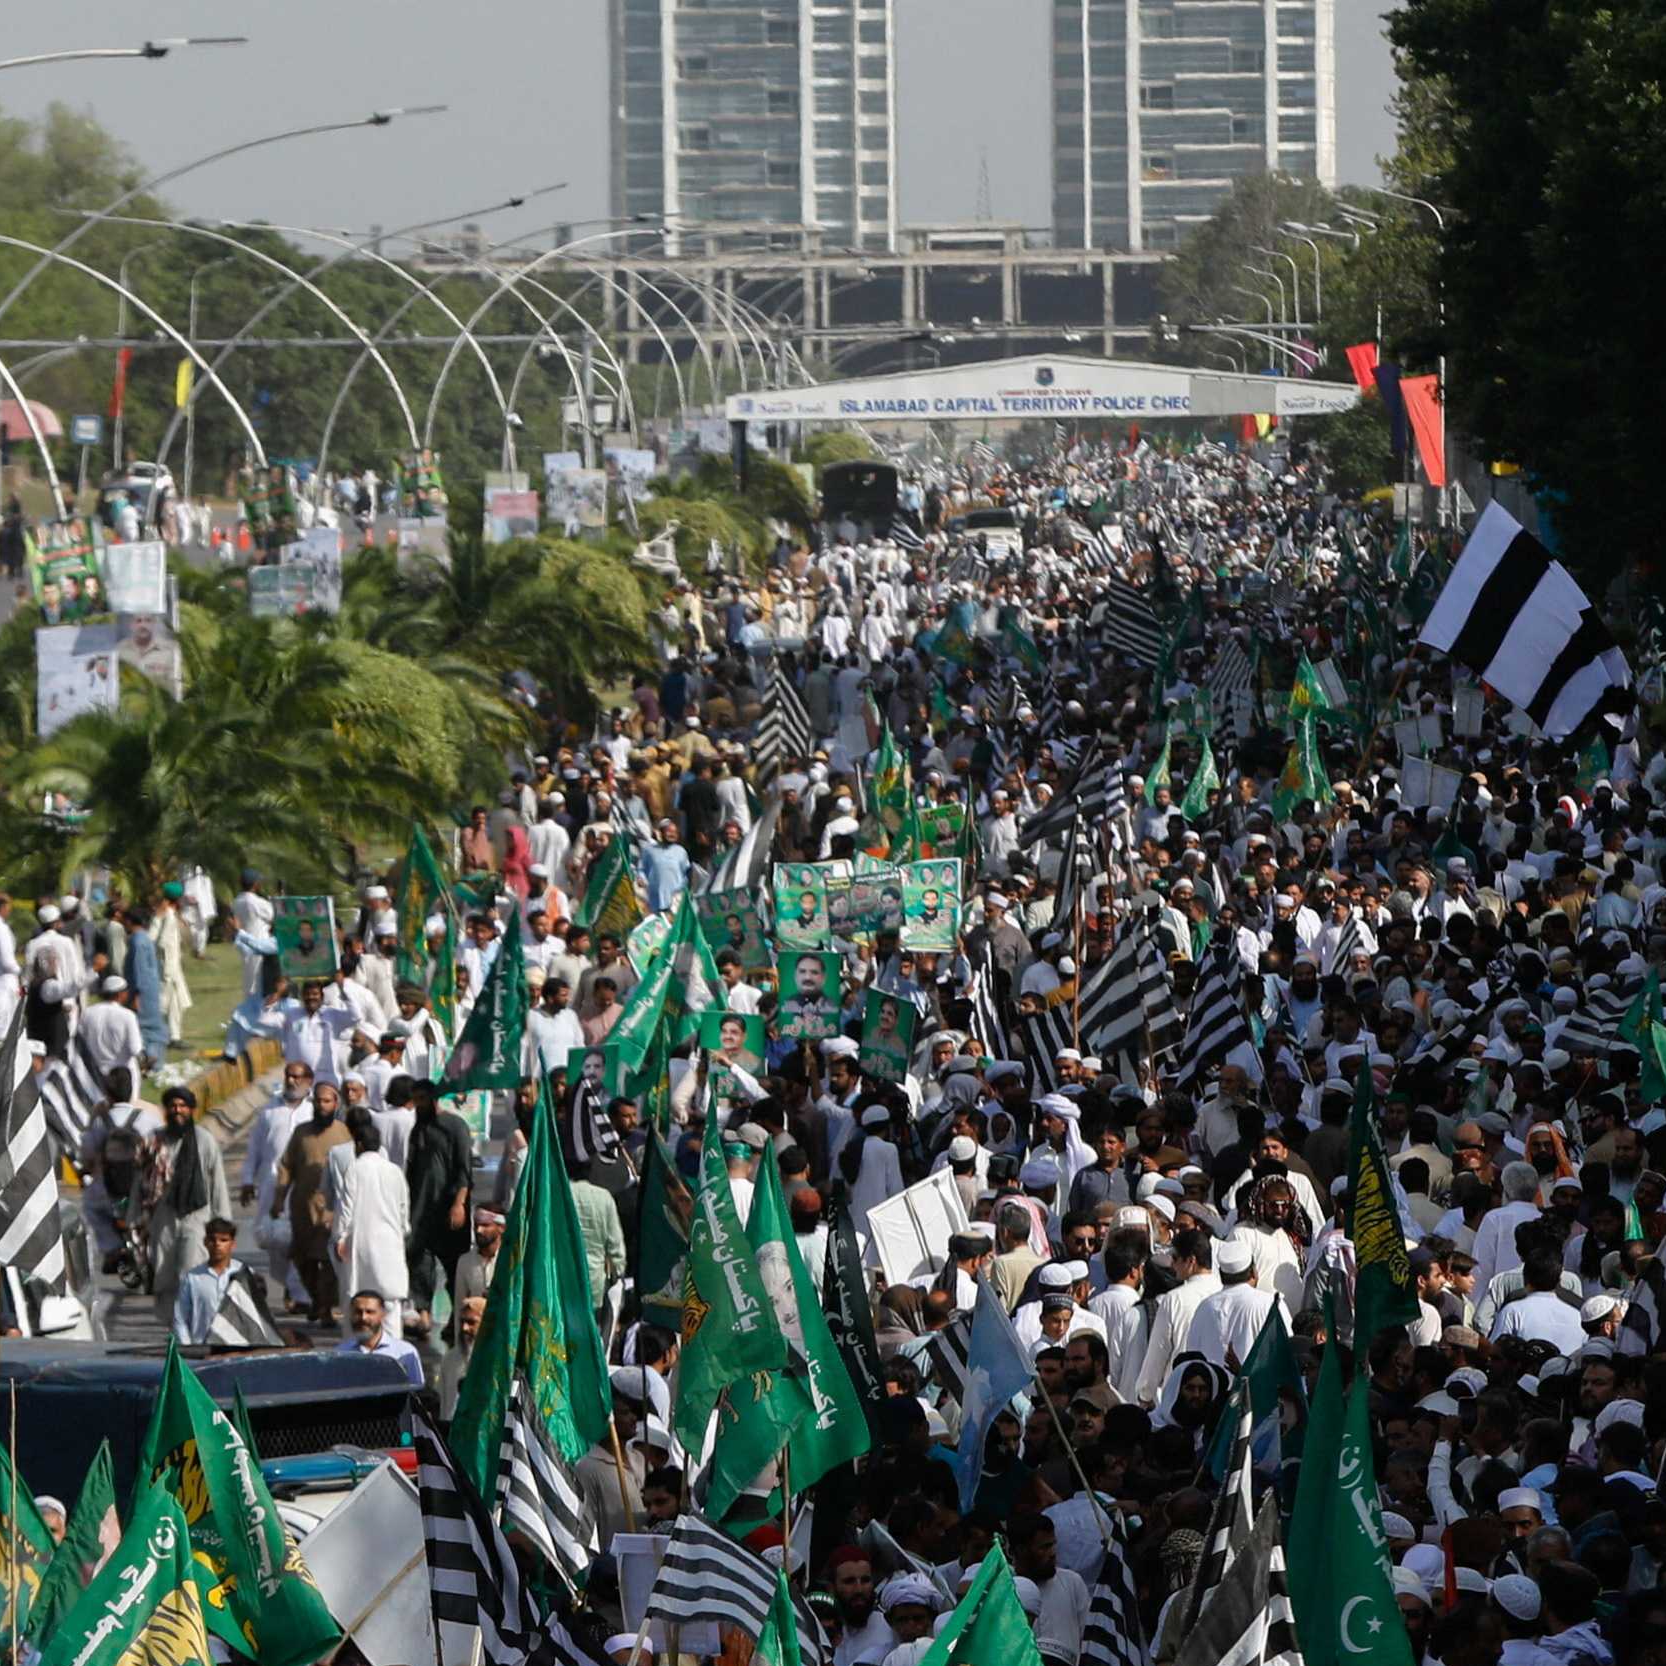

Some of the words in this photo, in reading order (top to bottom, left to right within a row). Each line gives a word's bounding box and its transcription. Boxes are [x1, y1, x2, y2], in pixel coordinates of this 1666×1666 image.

[839, 399, 929, 413] ISLAMABAD
[934, 398, 997, 412] CAPITAL
[1003, 398, 1088, 412] TERRITORY
[1093, 397, 1146, 411] POLICE
[712, 1246, 763, 1333] پاکستان
[805, 1350, 839, 1430] پاکستا
